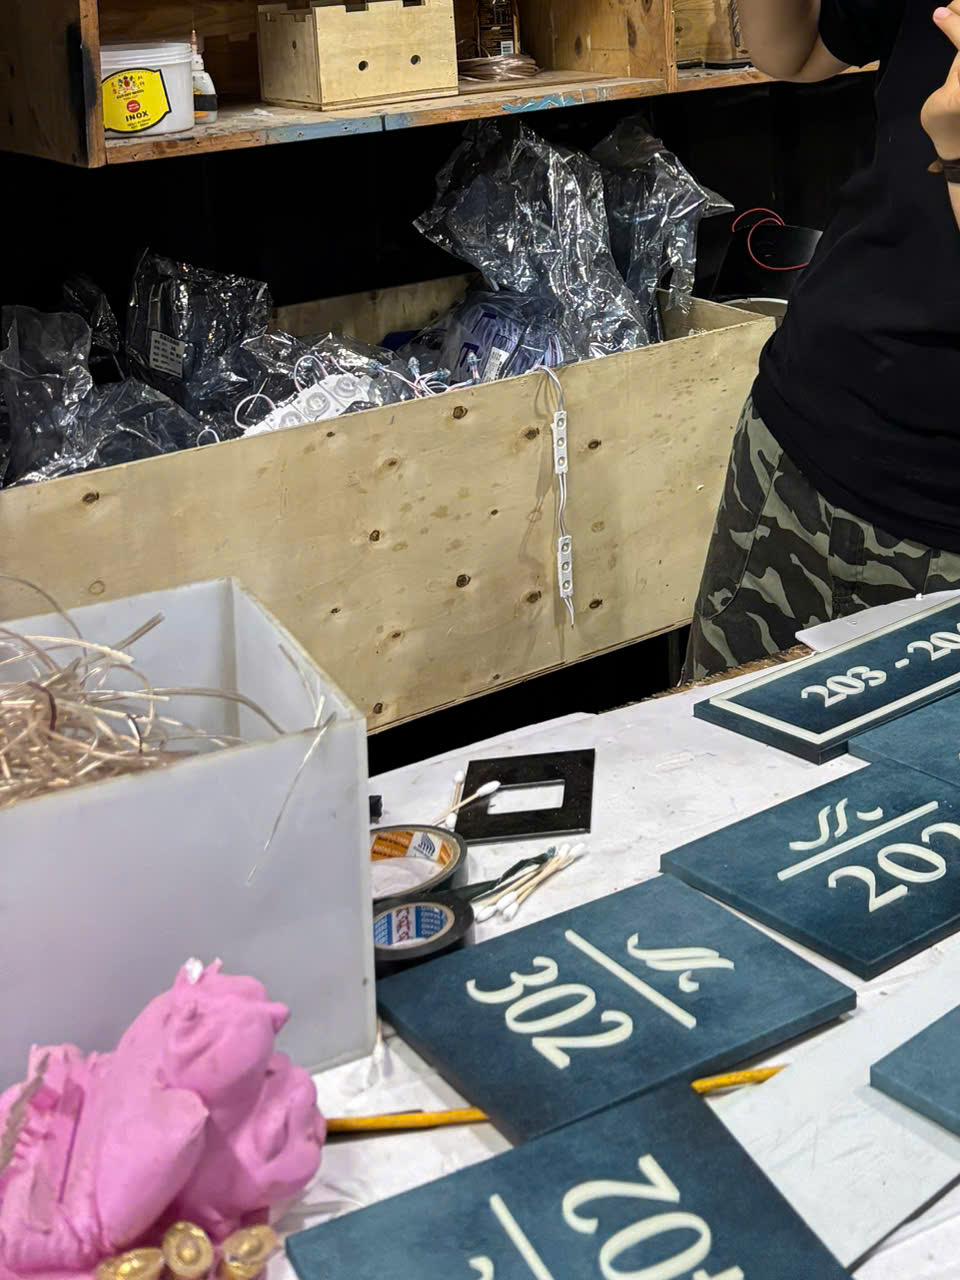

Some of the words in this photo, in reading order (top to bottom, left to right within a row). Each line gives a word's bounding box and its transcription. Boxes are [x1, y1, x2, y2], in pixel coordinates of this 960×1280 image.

[125, 110, 149, 122] INOX
[800, 665, 887, 707] 203
[466, 956, 634, 1071] 302
